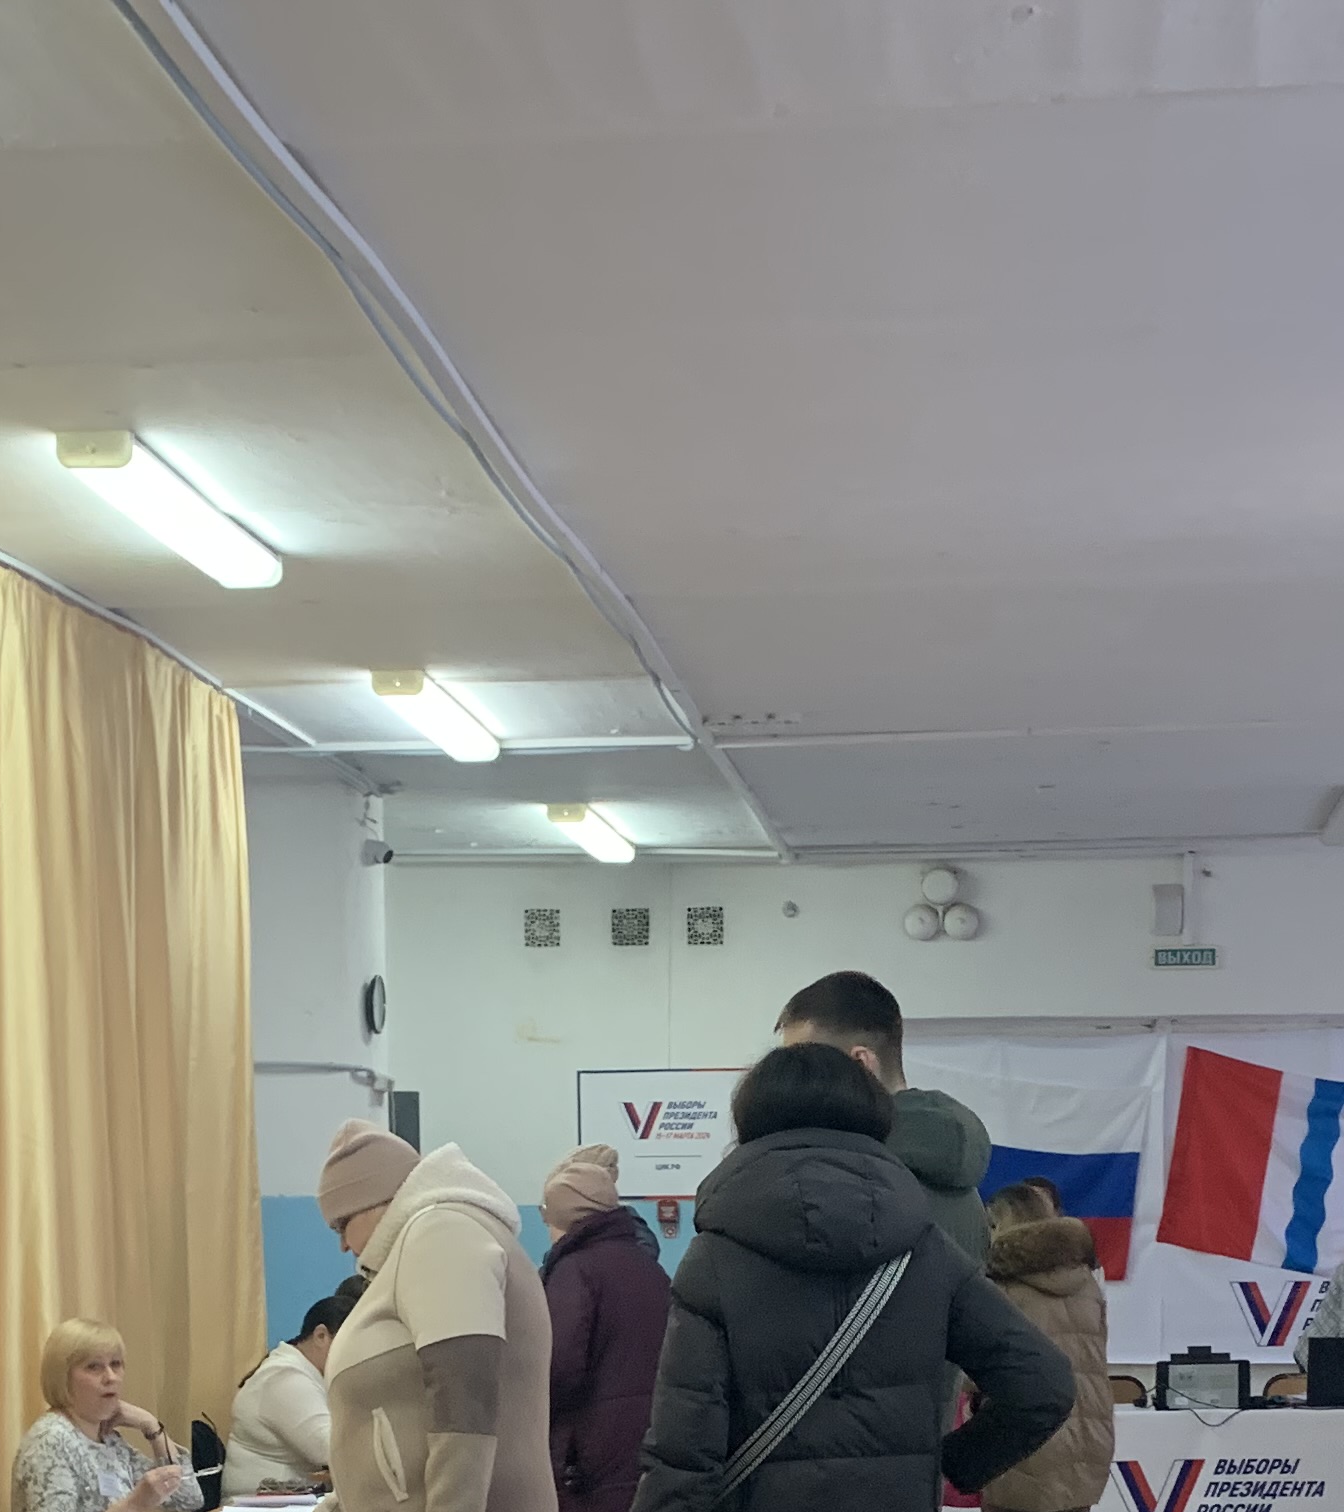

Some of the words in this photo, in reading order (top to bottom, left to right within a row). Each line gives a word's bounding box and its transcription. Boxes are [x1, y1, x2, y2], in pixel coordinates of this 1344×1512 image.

[1157, 951, 1213, 964] ВЫХОД
[667, 1101, 706, 1109] ВЫБОРЫ
[663, 1111, 717, 1120] ПРЕЗИДЕНТА
[658, 1122, 694, 1130] РОССИИ
[1213, 1458, 1301, 1476] ВЫБОРЫ
[1203, 1480, 1325, 1499] ПРЕЗИДЕНТА
